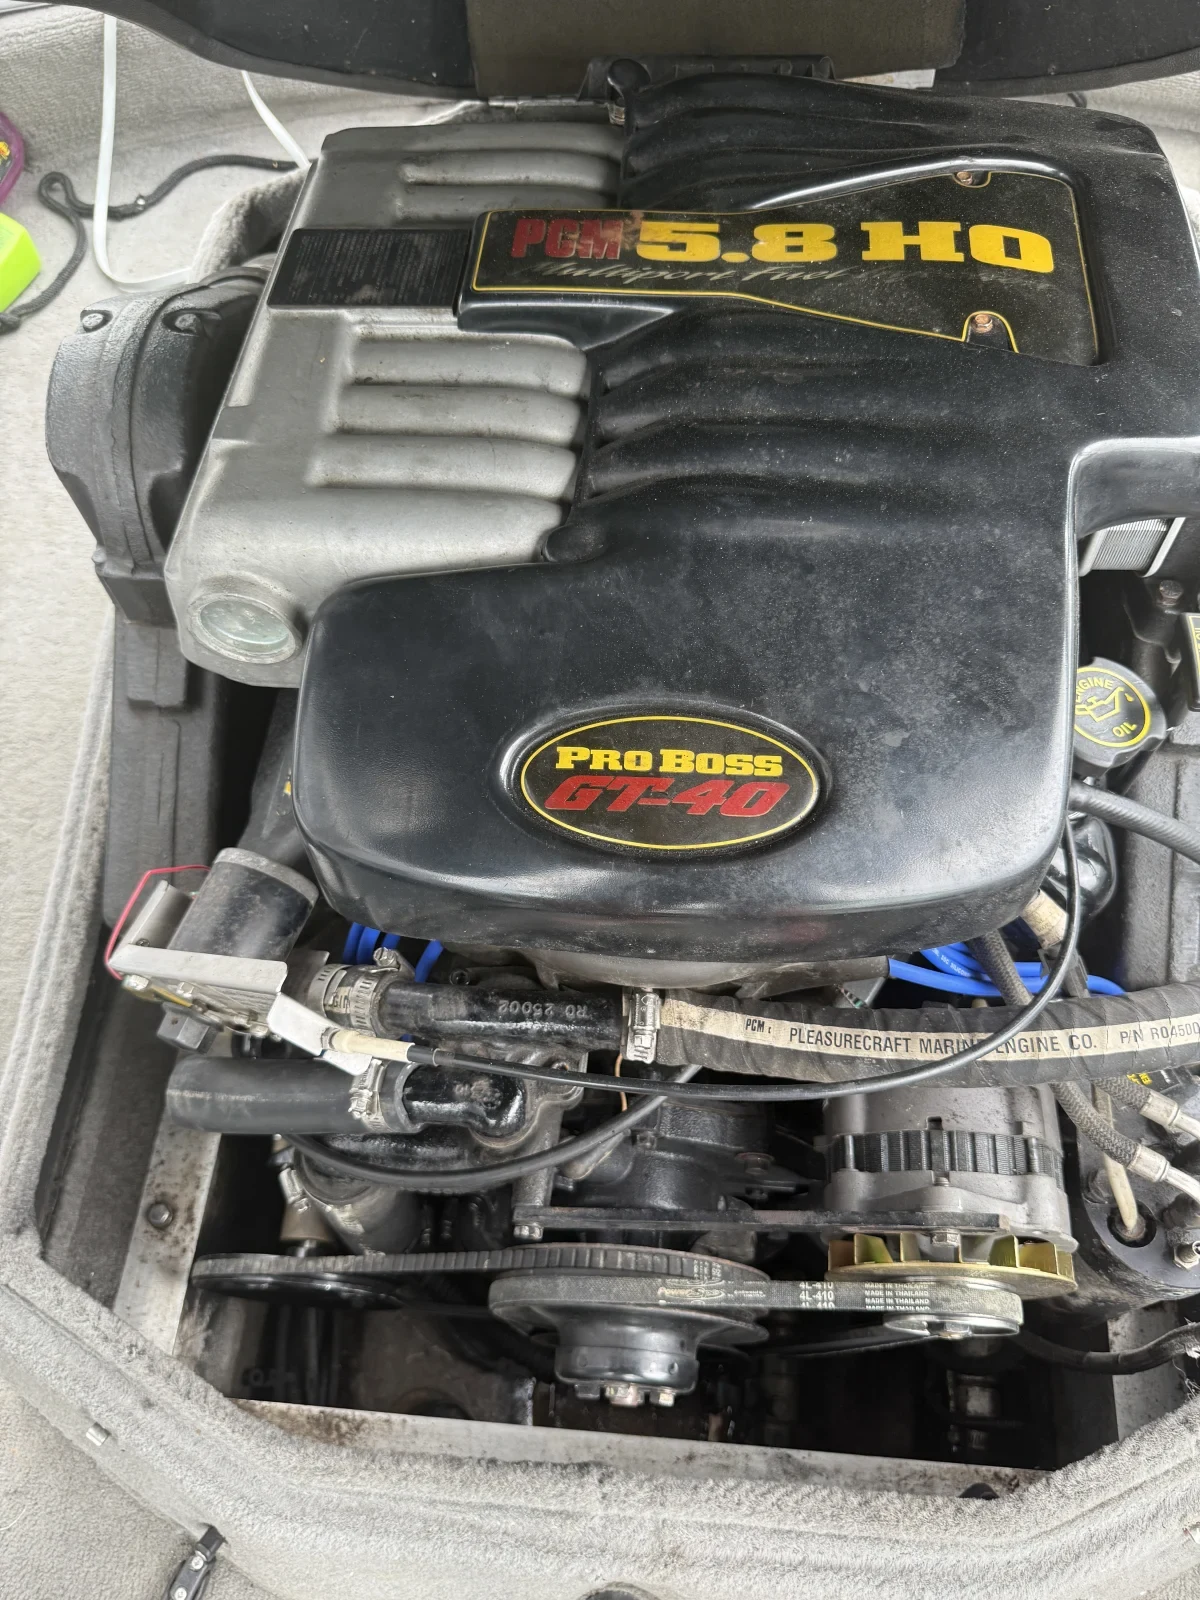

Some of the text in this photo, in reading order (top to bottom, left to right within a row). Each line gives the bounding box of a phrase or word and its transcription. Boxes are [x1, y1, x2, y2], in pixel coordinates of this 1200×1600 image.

[511, 219, 1055, 273] PCM 5.8 HO
[742, 264, 860, 281] Fuel
[1112, 722, 1137, 737] OIL
[556, 746, 783, 777] PRO BOSS
[544, 775, 790, 818] GT-40
[498, 1000, 555, 1016] 25002
[745, 1018, 765, 1033] PCM
[789, 1028, 911, 1053] PLEASURECRAFT
[919, 1038, 988, 1056] MARIN
[1068, 1034, 1097, 1051] CO.
[1119, 1029, 1144, 1044] P/N
[799, 1290, 835, 1301] 4L-410
